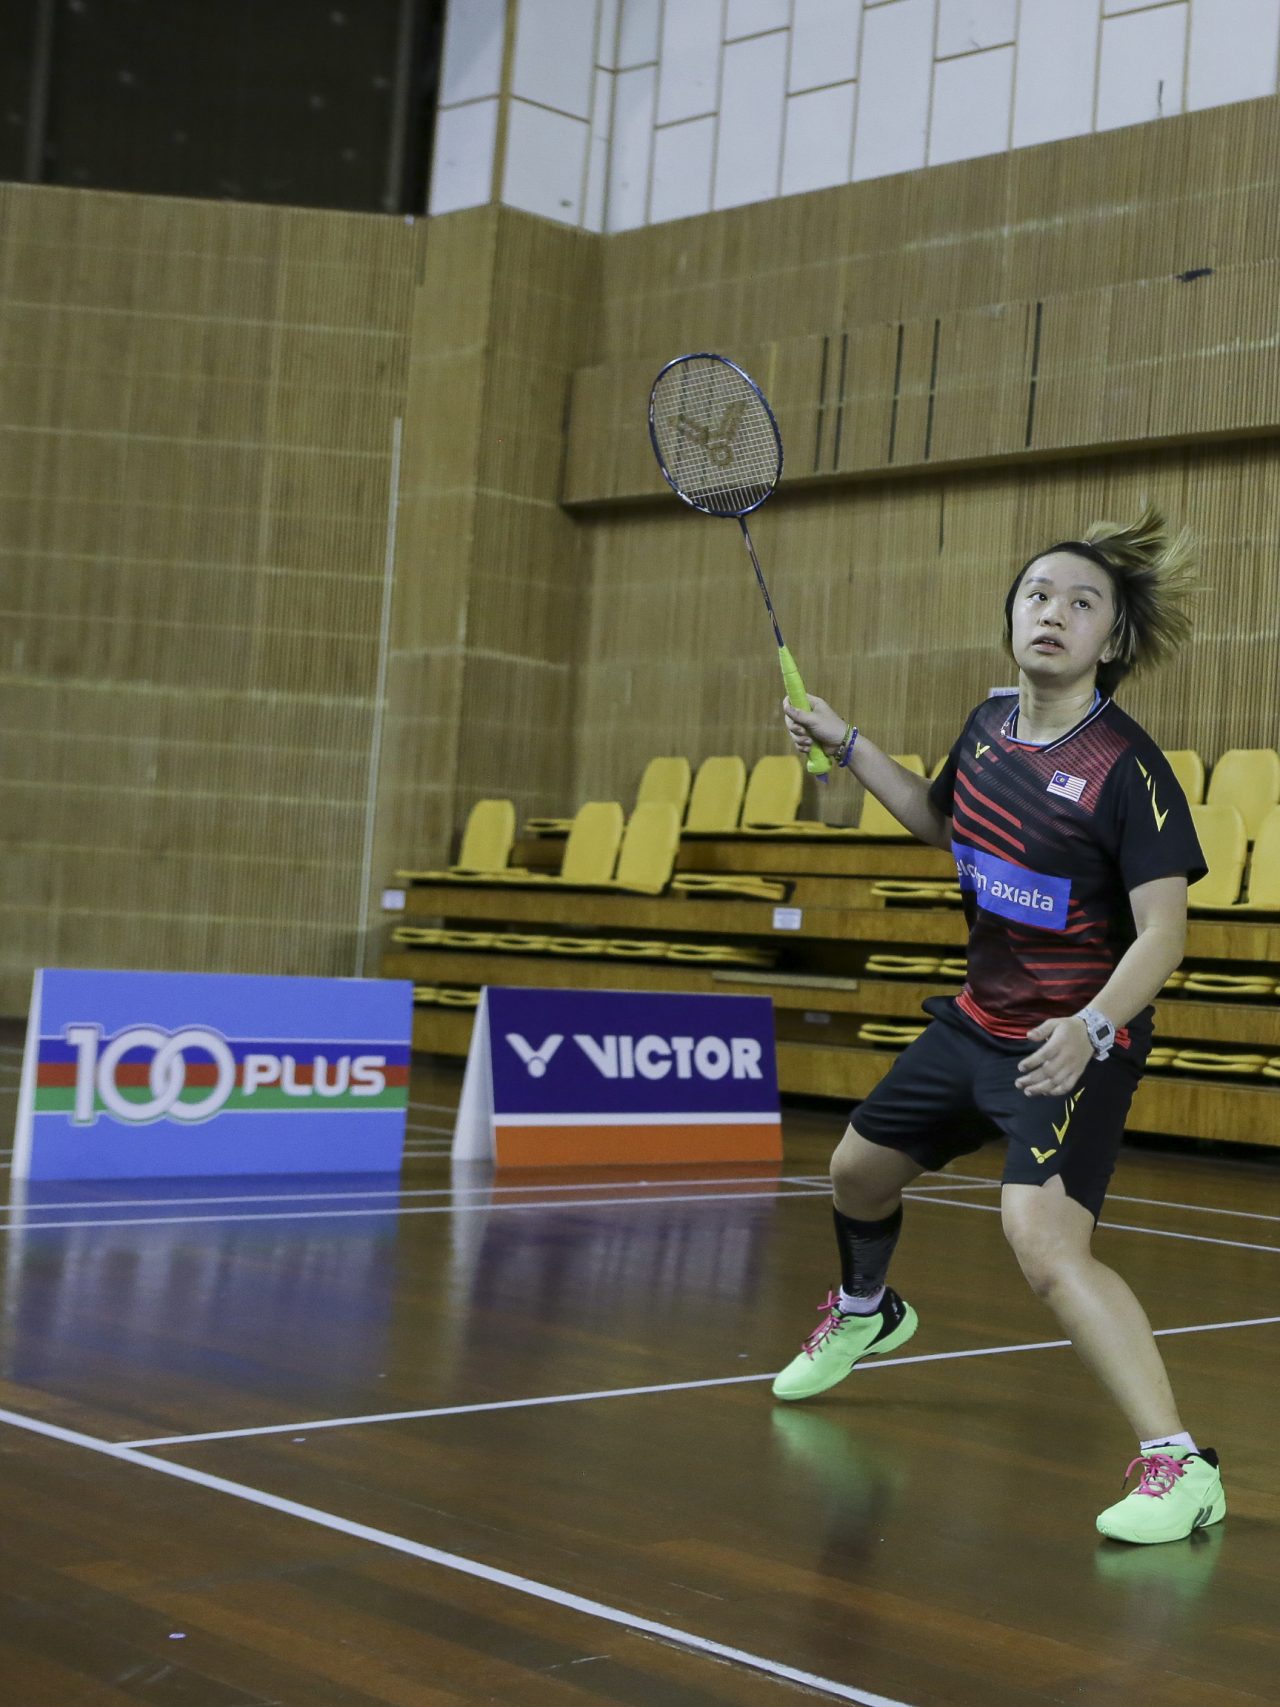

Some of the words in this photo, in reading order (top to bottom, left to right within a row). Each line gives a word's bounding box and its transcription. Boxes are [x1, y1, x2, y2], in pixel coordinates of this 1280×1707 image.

[991, 880, 1054, 912] axiata
[65, 1025, 236, 1124] 100
[242, 1054, 387, 1097] PLUS
[572, 1033, 764, 1081] VICTOR
